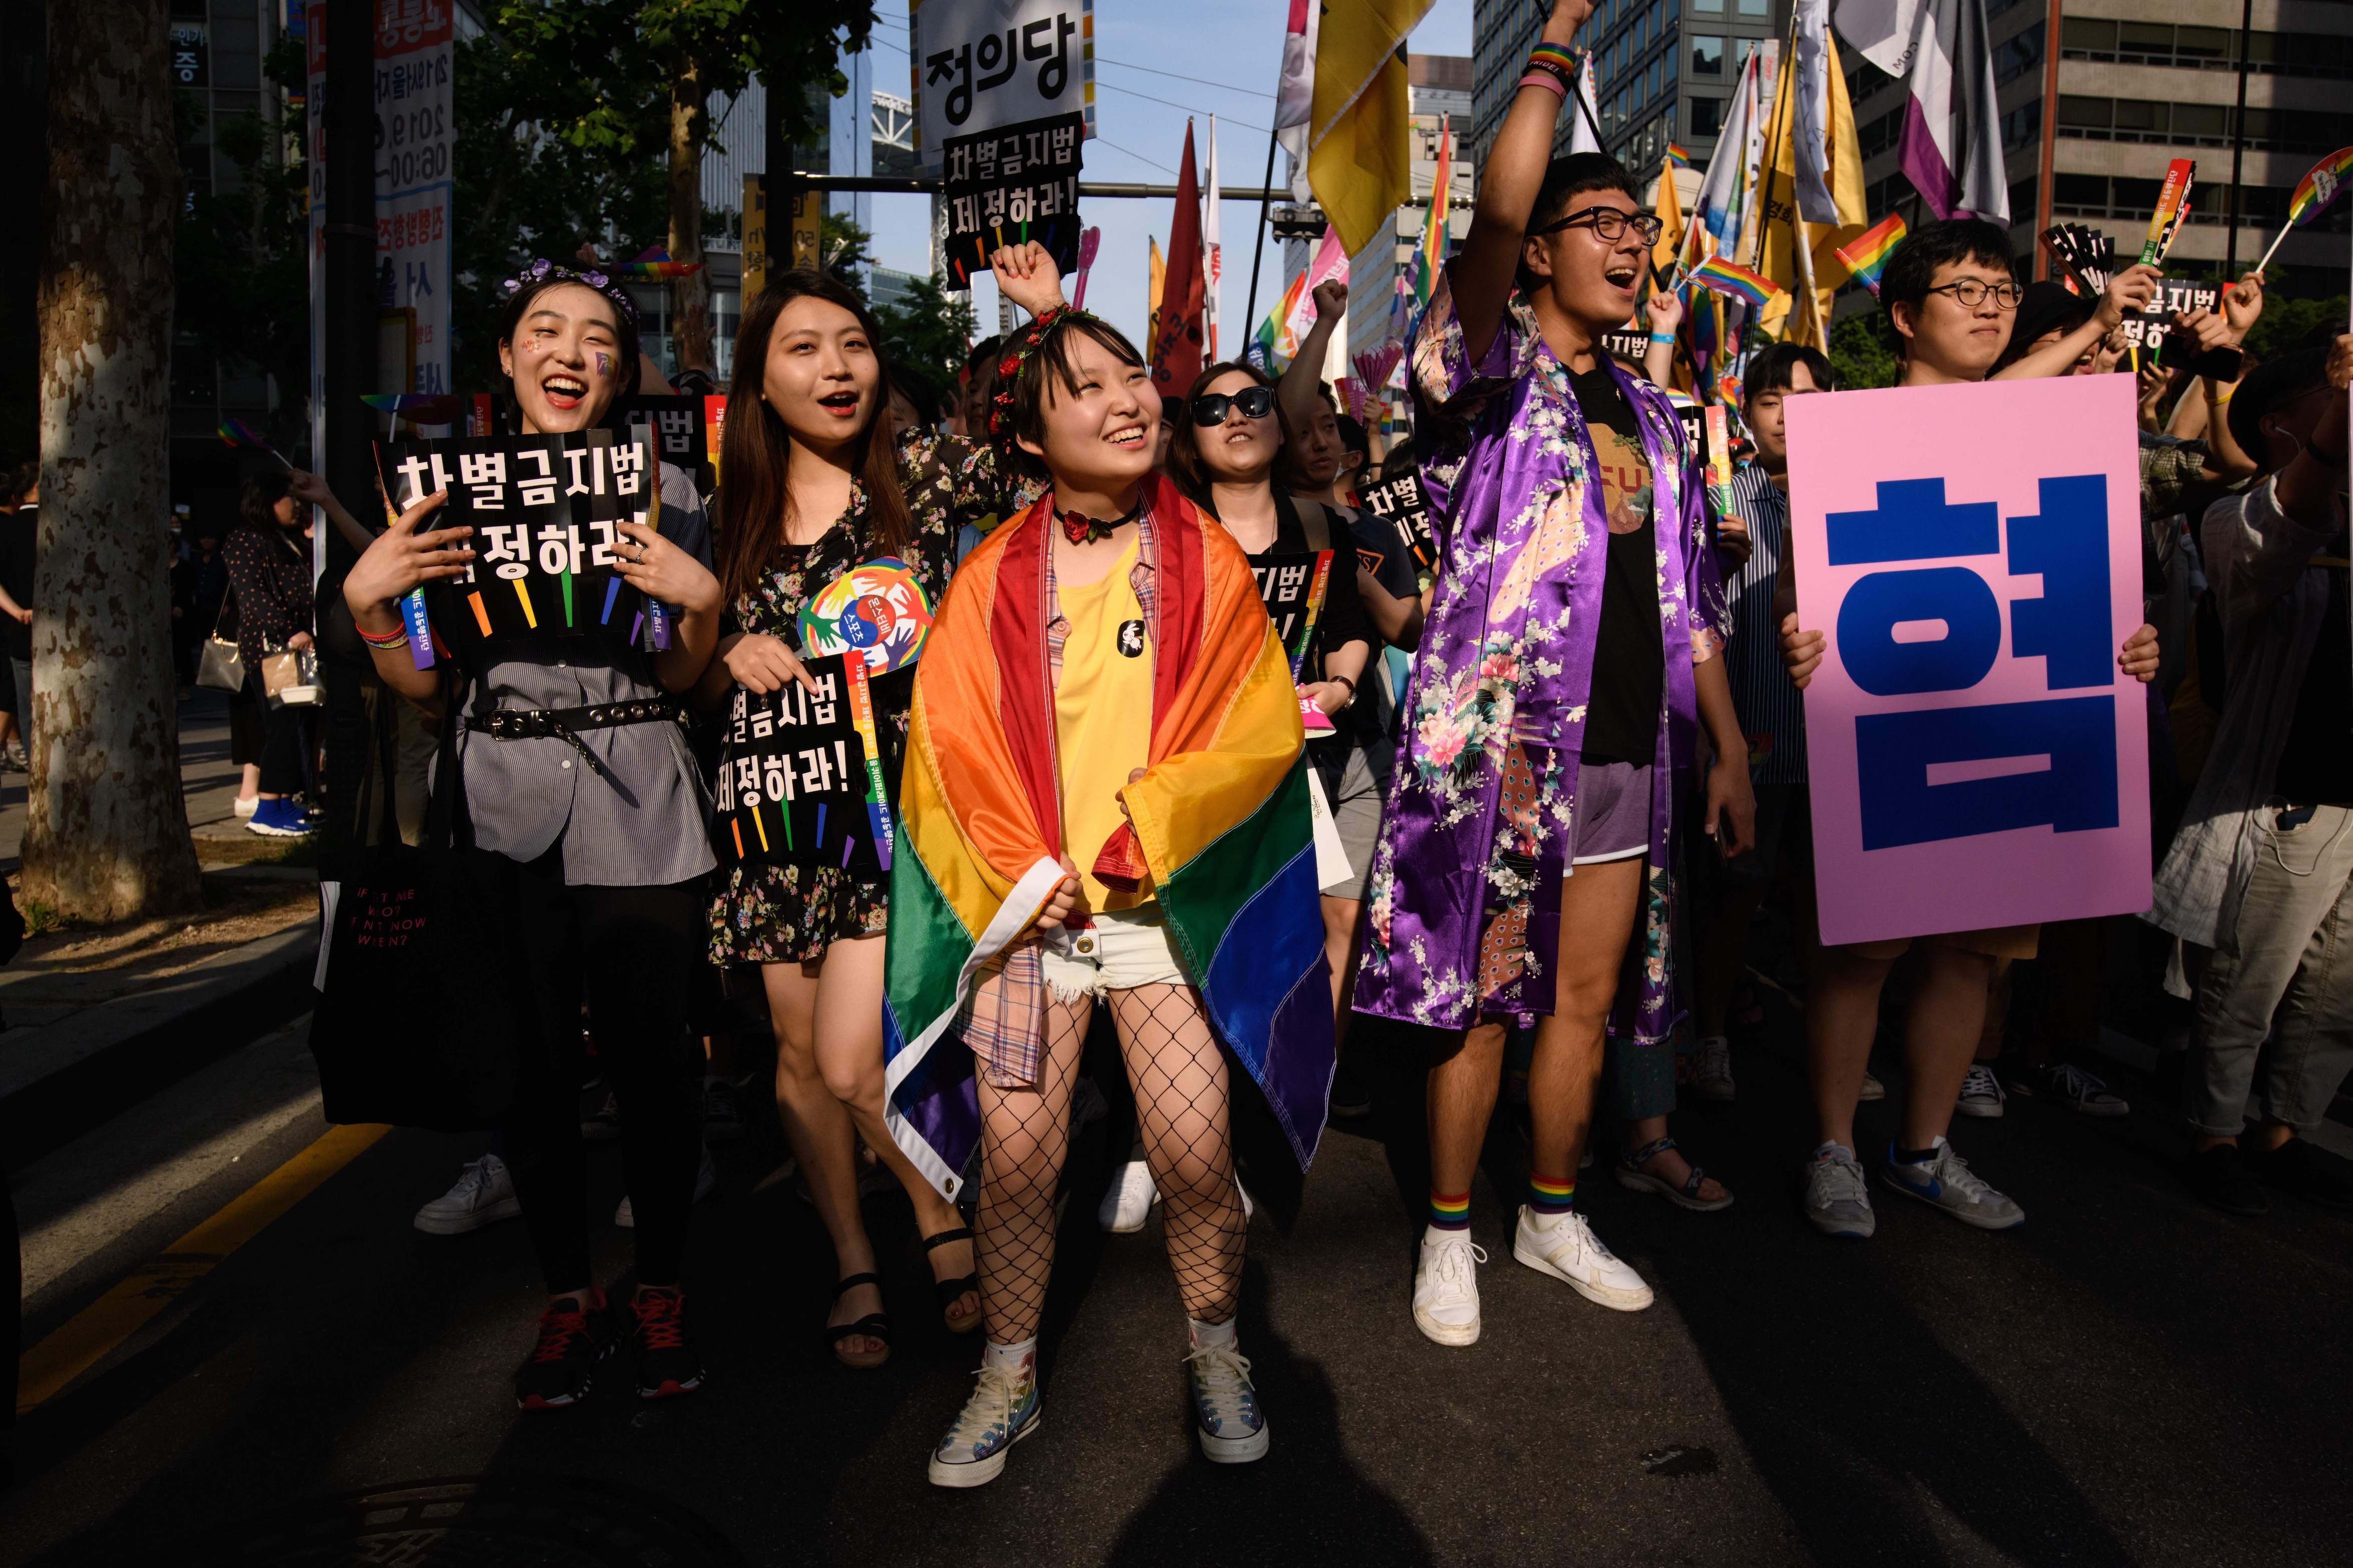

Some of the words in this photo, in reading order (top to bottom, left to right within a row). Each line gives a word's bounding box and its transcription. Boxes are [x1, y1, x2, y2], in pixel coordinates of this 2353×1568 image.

[926, 13, 1075, 126] 정의당
[949, 126, 1075, 183] 차별금지법
[953, 176, 1075, 235] 제정하라!
[397, 442, 644, 510] 차별금지법
[1365, 475, 1419, 516] 차별
[414, 611, 430, 651] 공동행진단
[844, 614, 864, 643] 스포츠
[868, 597, 892, 635] 몬스터비
[1825, 473, 2119, 851] 혐
[856, 664, 869, 704] 차별금지법
[863, 706, 873, 730] 제정을
[865, 732, 875, 749] 위한
[717, 740, 849, 813] 제정하라!
[869, 752, 888, 814] 서울퀴어퍼레이드
[396, 889, 416, 902] ME
[363, 920, 383, 933] NT
[390, 916, 428, 933] NOW
